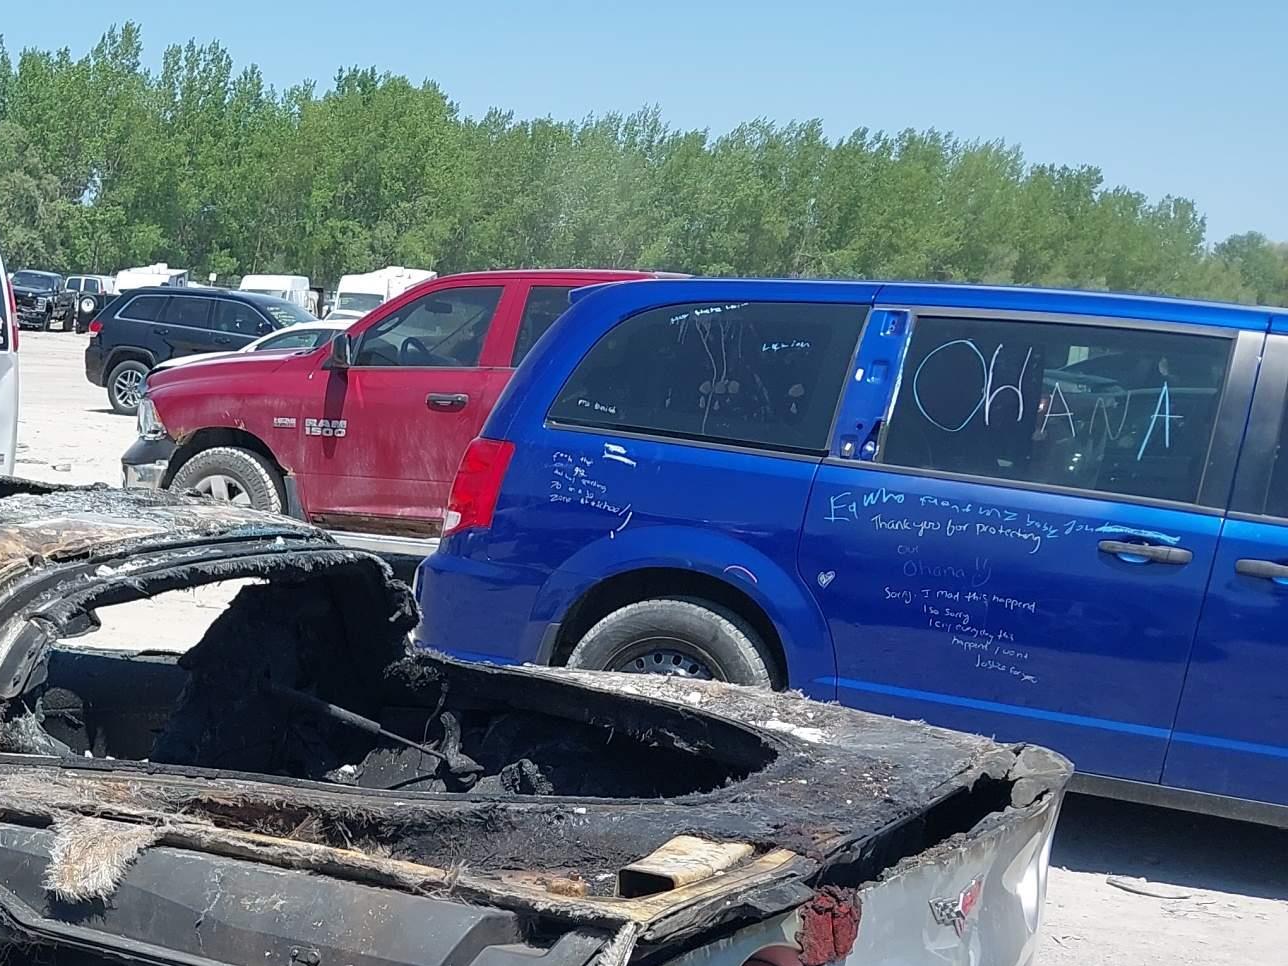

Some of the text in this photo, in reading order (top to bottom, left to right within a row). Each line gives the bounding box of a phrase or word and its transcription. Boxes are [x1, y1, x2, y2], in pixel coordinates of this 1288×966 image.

[305, 418, 347, 429] RAM
[305, 427, 346, 438] 1500
[871, 514, 911, 531] Thank
[912, 521, 941, 537] you
[946, 519, 969, 537] for
[903, 559, 965, 578] Ohana
[921, 588, 932, 598] I
